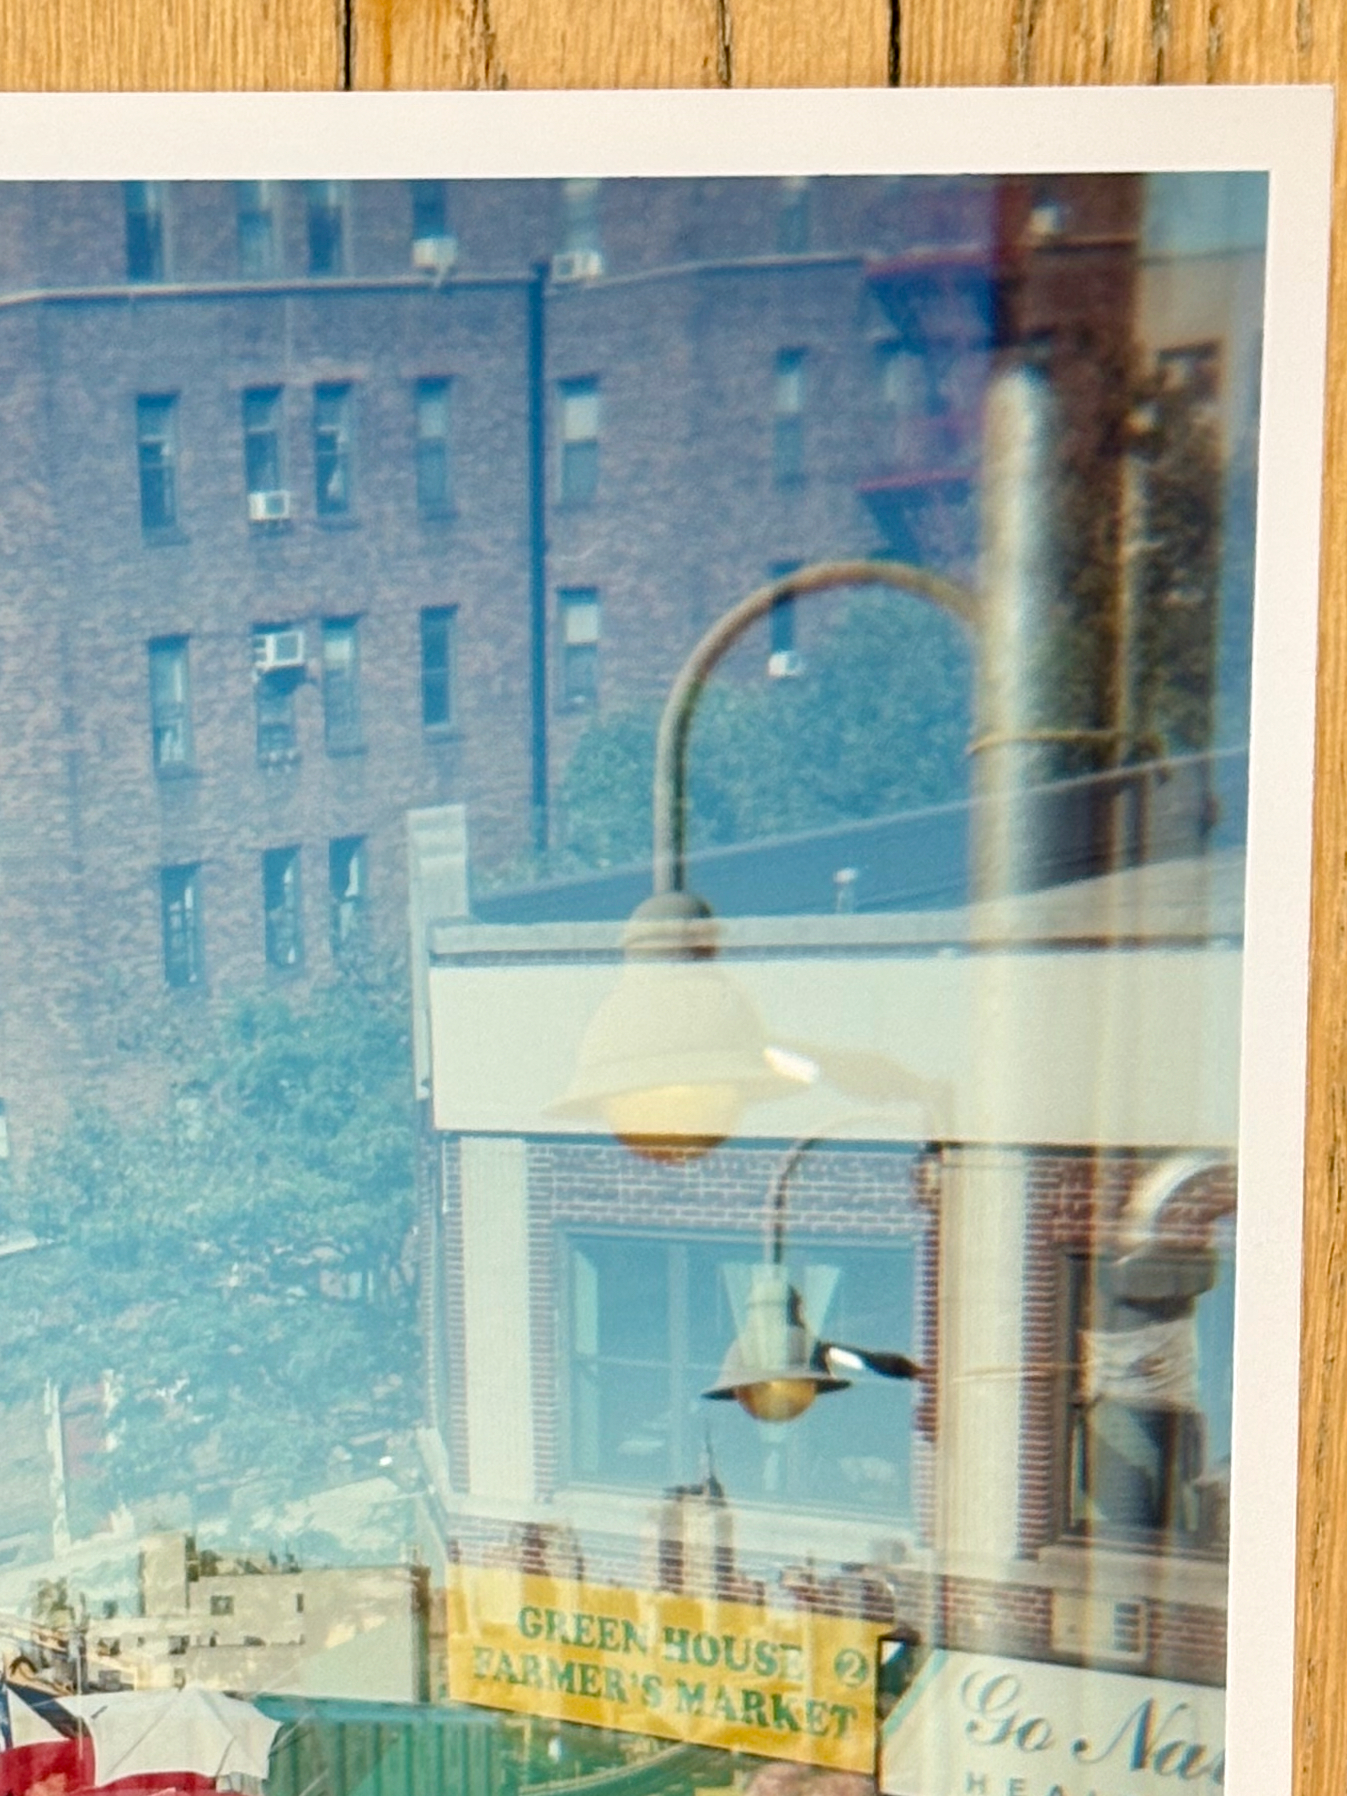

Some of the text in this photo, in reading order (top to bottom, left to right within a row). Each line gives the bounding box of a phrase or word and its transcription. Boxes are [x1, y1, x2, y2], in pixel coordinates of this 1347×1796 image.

[517, 1605, 650, 1656] GREEN
[663, 1625, 806, 1682] HOUSE
[472, 1646, 858, 1740] FARMER'S MARKET
[961, 1669, 1053, 1753] Go
